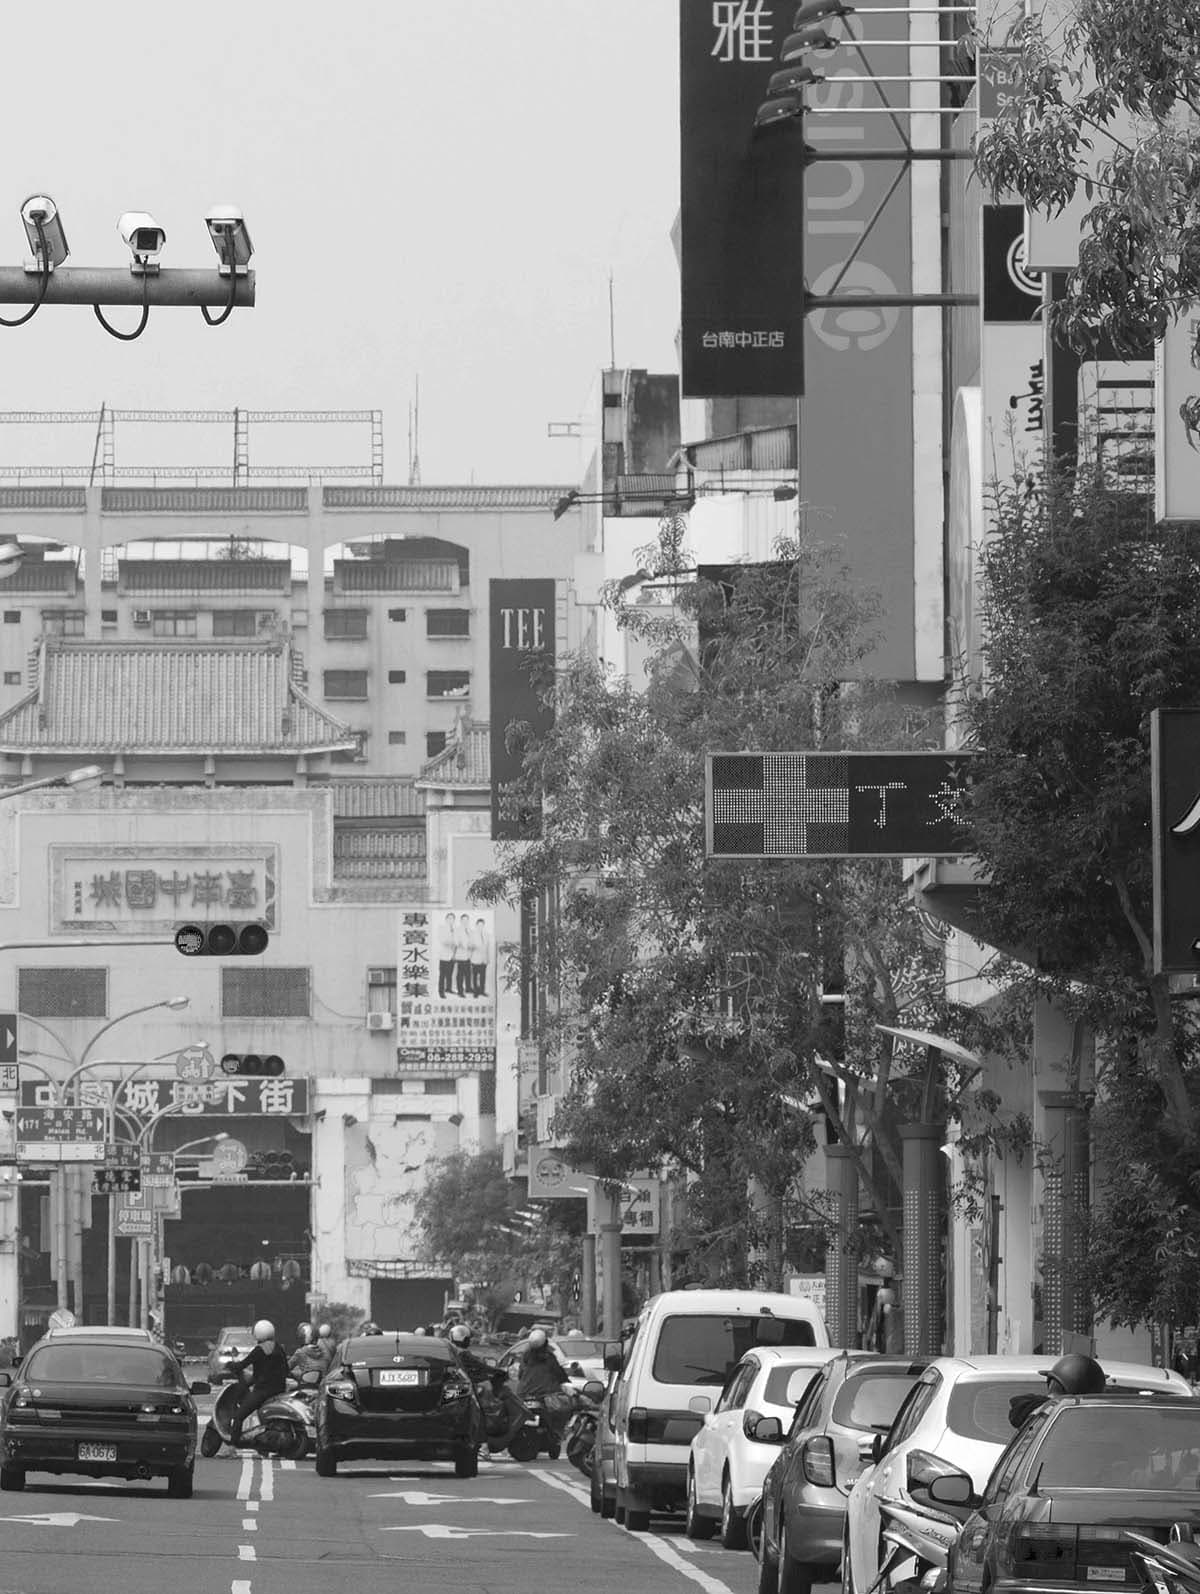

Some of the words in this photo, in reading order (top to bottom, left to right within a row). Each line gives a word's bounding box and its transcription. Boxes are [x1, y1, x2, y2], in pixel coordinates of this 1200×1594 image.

[711, 0, 773, 61] 雅
[702, 331, 784, 348] 台南中正店
[500, 608, 545, 648] TEE
[2, 1067, 16, 1080] 北
[43, 1109, 92, 1120] 海安路
[24, 1119, 40, 1129] 171
